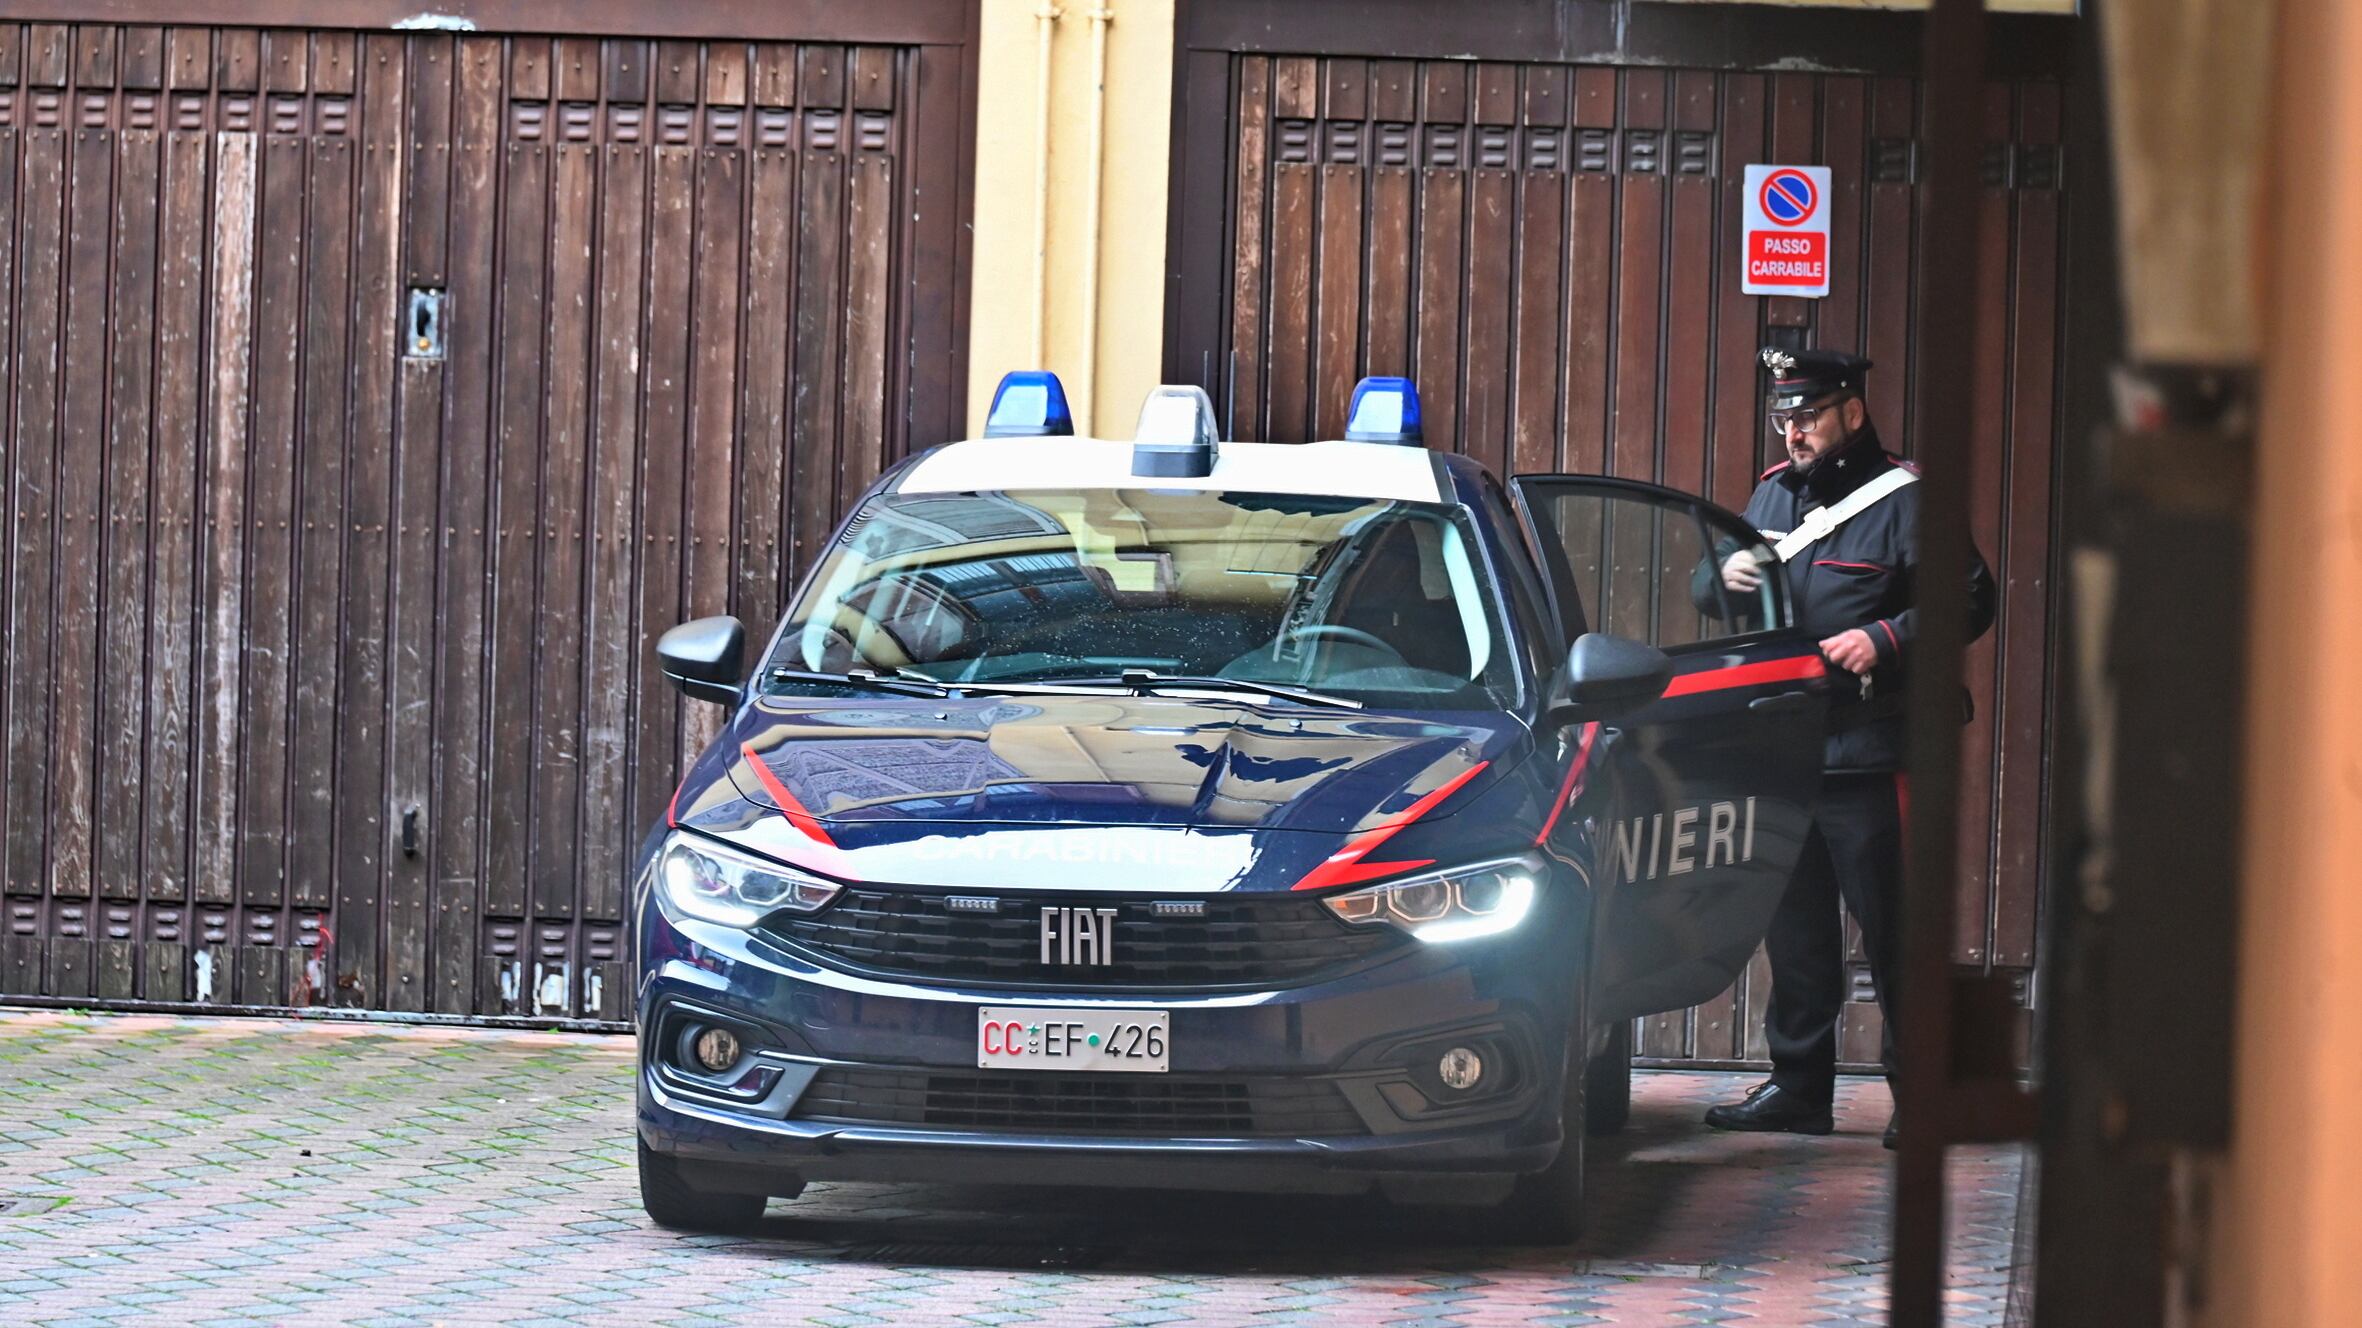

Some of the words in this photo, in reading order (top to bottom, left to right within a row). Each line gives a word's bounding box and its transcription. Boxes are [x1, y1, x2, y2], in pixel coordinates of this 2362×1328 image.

[1764, 238, 1811, 254] PASSO
[1751, 260, 1822, 277] CARRABILE
[912, 833, 1242, 866] CARABINIER
[1040, 907, 1118, 966] FIAT
[983, 1020, 1023, 1056] CC
[1044, 1022, 1084, 1057] EF
[1104, 1023, 1164, 1058] 426
